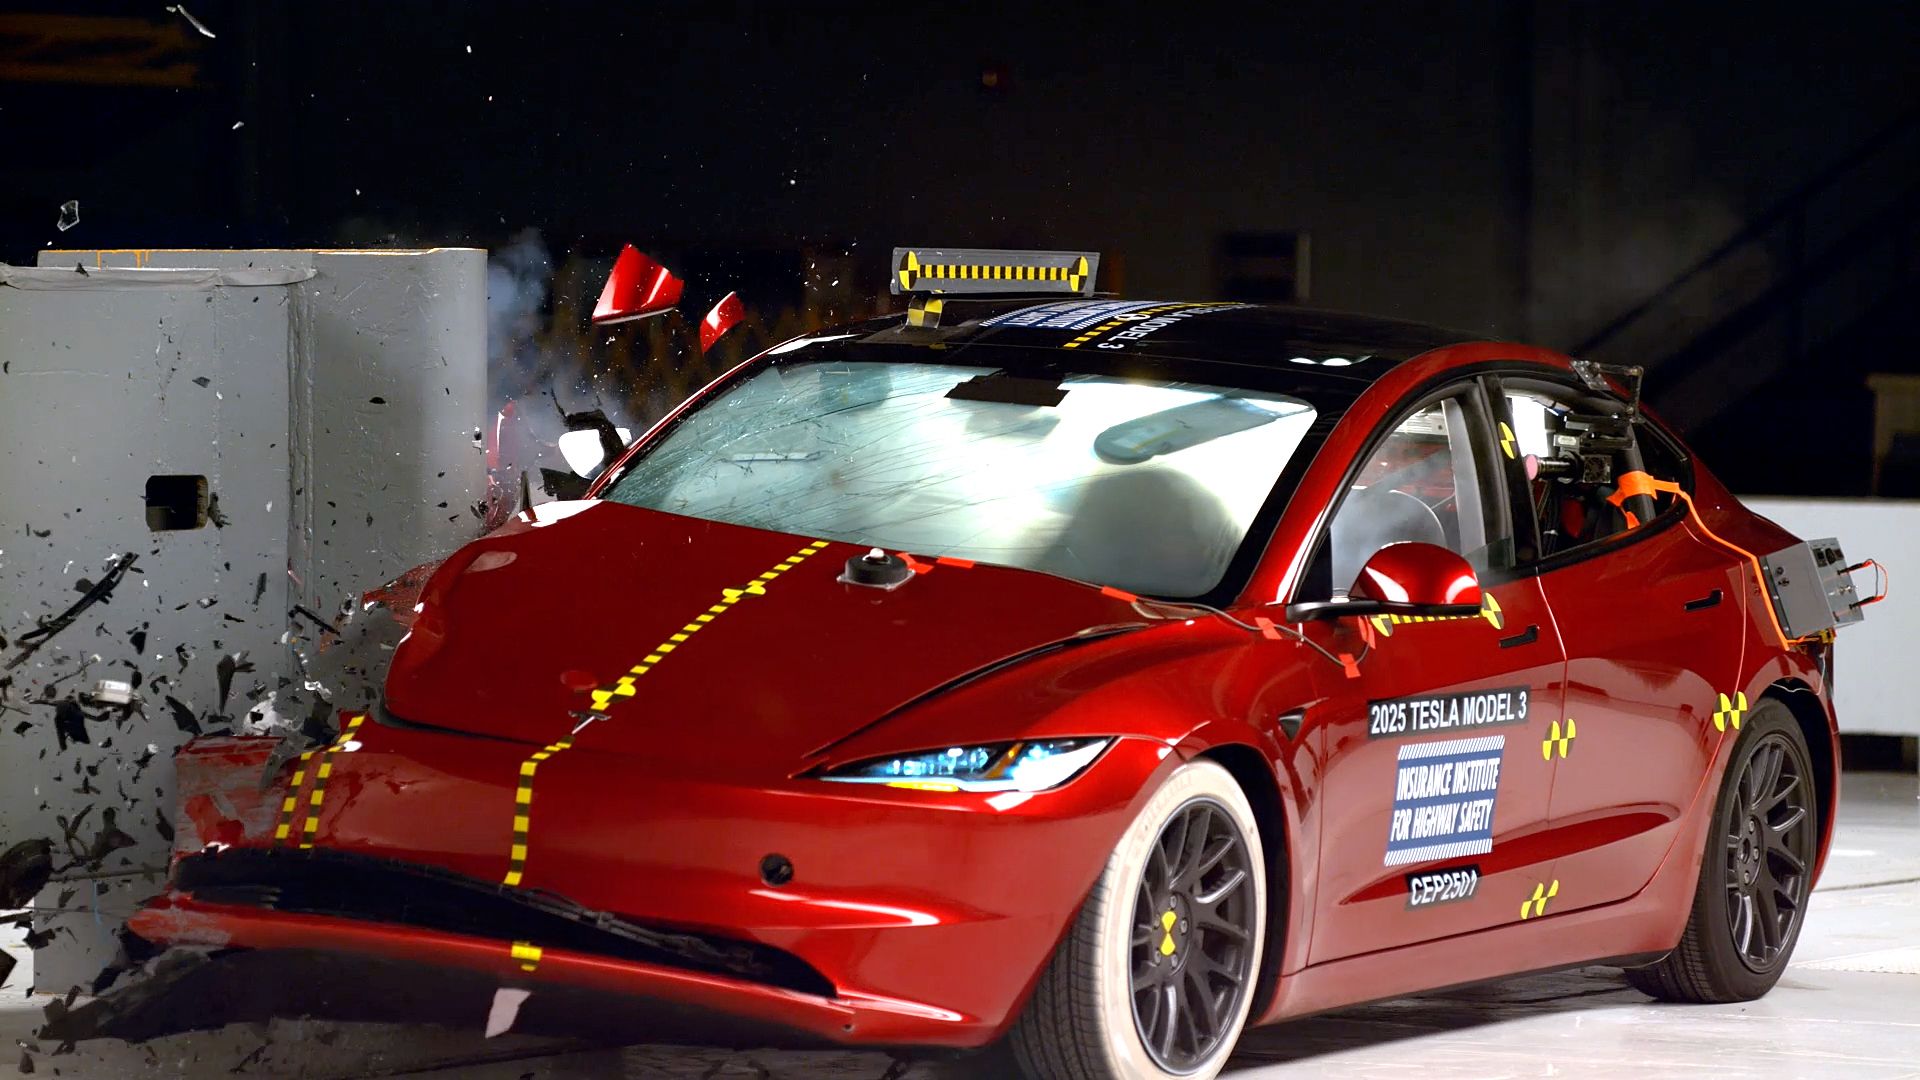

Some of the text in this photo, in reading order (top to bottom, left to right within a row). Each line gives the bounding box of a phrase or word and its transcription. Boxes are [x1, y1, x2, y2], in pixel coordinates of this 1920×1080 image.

[1097, 342, 1124, 350] 3
[1371, 691, 1527, 734] 2025 TESLA MODEL 3
[1396, 758, 1500, 801] INSURANCE INSTITUTE
[1390, 798, 1494, 842] FOR HIGHWAY SAFETY
[1411, 869, 1477, 905] CEP2501
